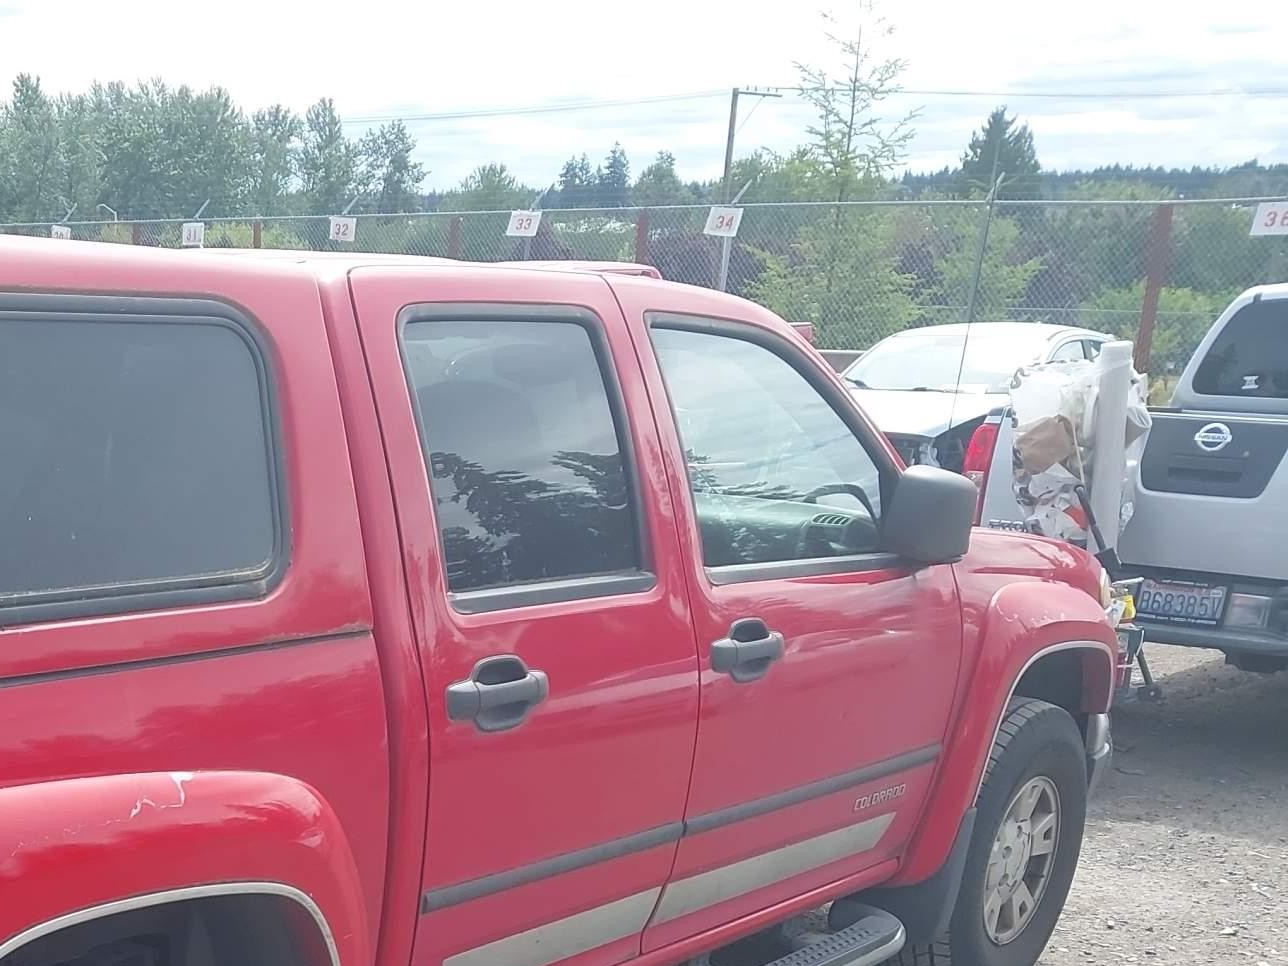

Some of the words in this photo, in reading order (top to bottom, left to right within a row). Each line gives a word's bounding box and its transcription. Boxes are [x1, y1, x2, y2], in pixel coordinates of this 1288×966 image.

[334, 223, 349, 236] 32
[515, 218, 532, 230] 33
[715, 215, 734, 230] 34
[186, 228, 197, 241] 31
[1139, 590, 1224, 619] B68385V
[854, 784, 906, 811] COLORADO
